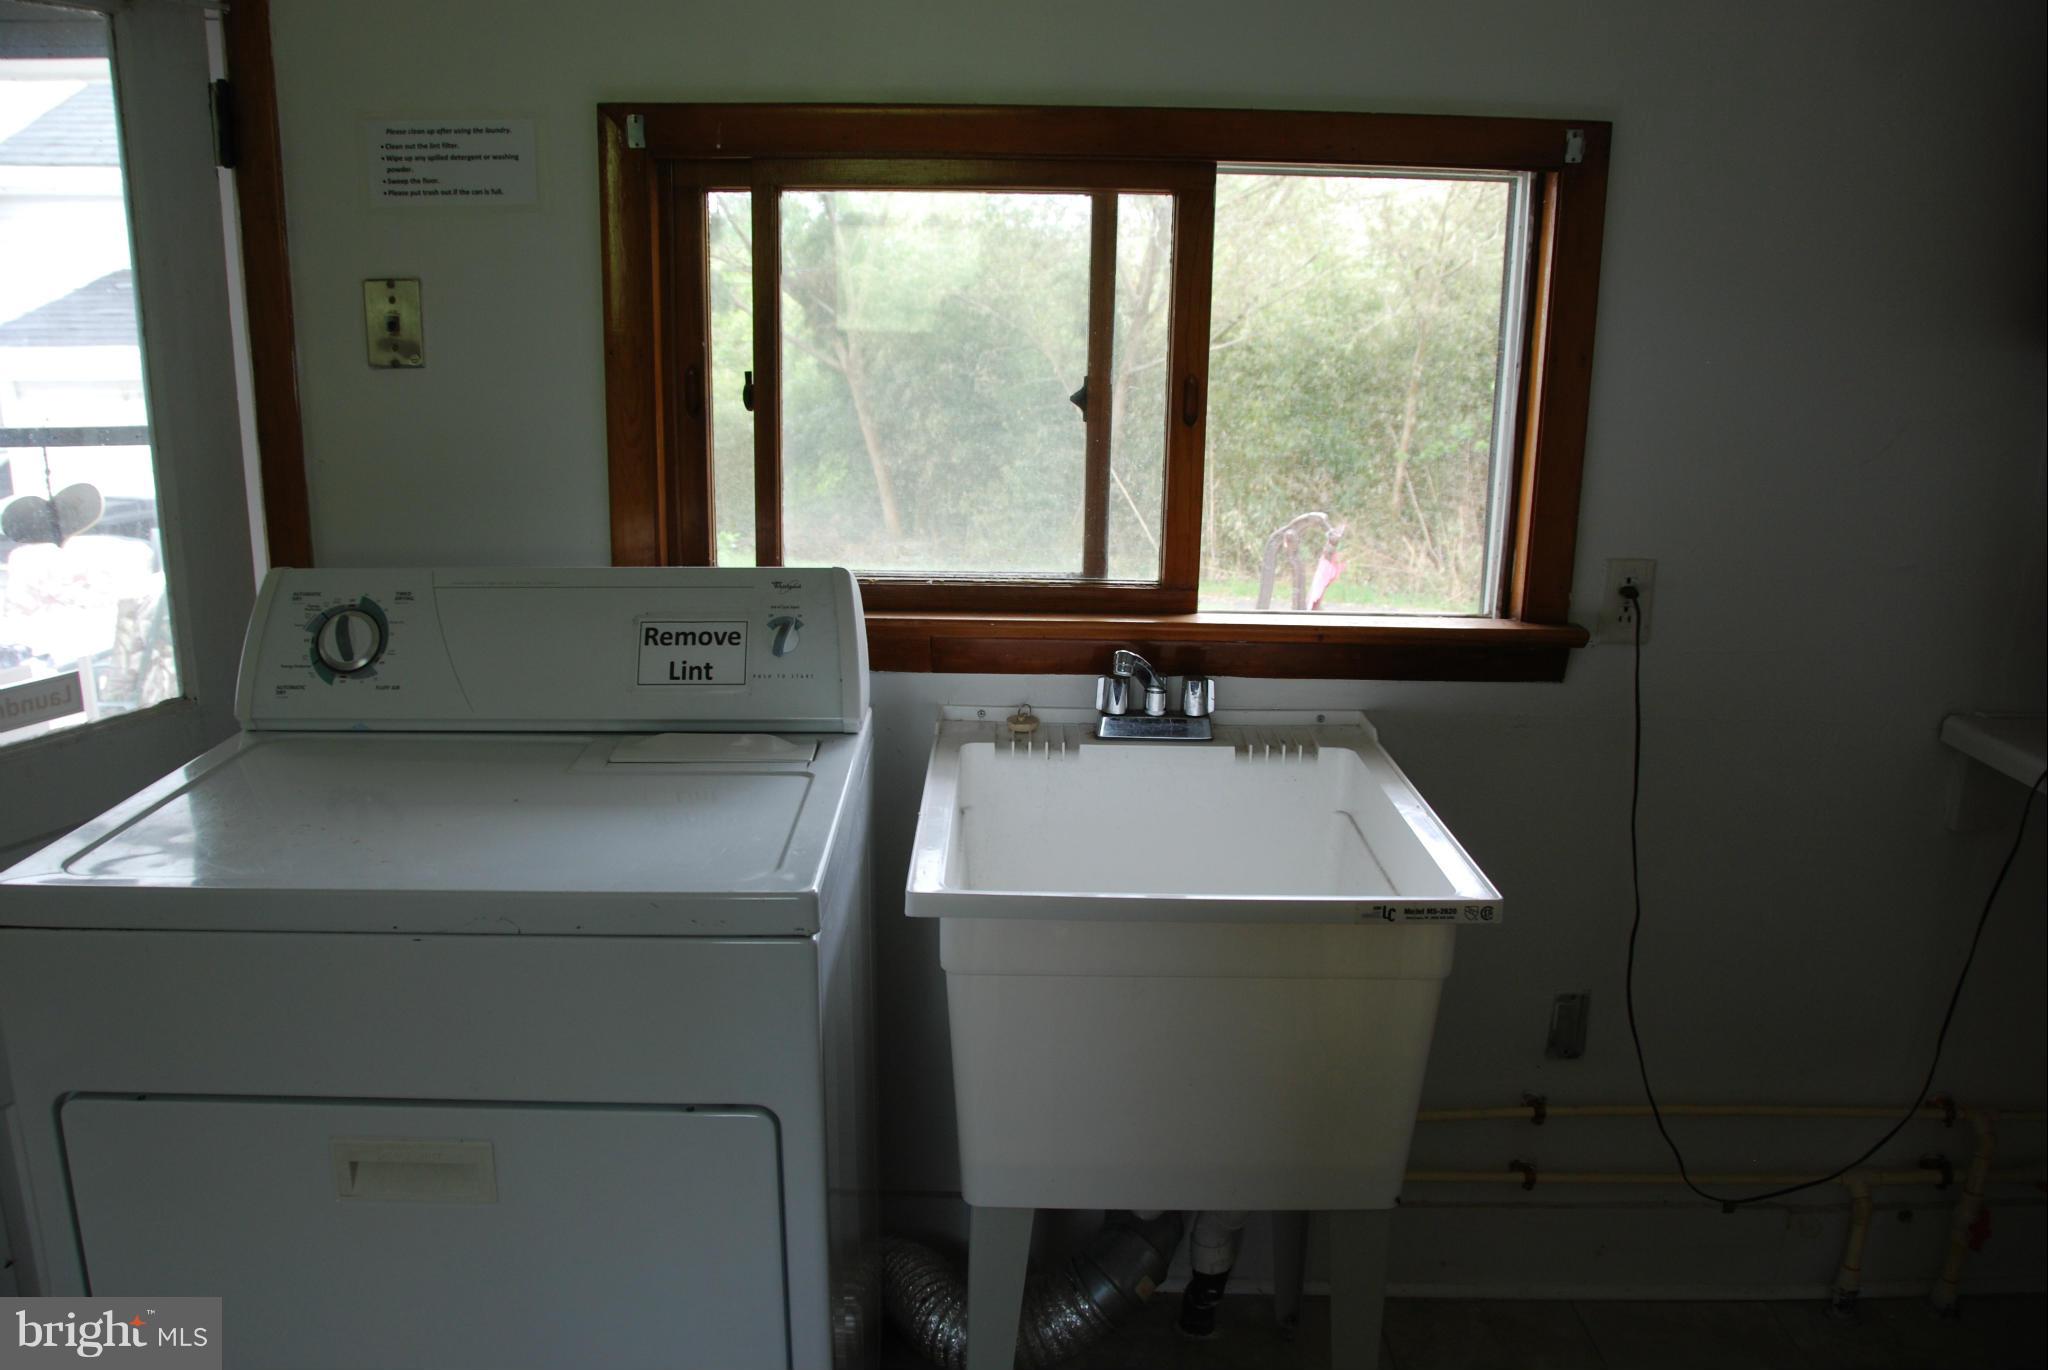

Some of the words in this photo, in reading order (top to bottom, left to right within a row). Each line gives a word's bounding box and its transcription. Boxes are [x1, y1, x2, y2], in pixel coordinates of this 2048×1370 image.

[436, 128, 453, 136] after
[454, 128, 472, 136] using
[450, 154, 482, 162] detergent
[492, 154, 520, 162] washing
[644, 627, 742, 646] Remove
[669, 660, 714, 681] Lint
